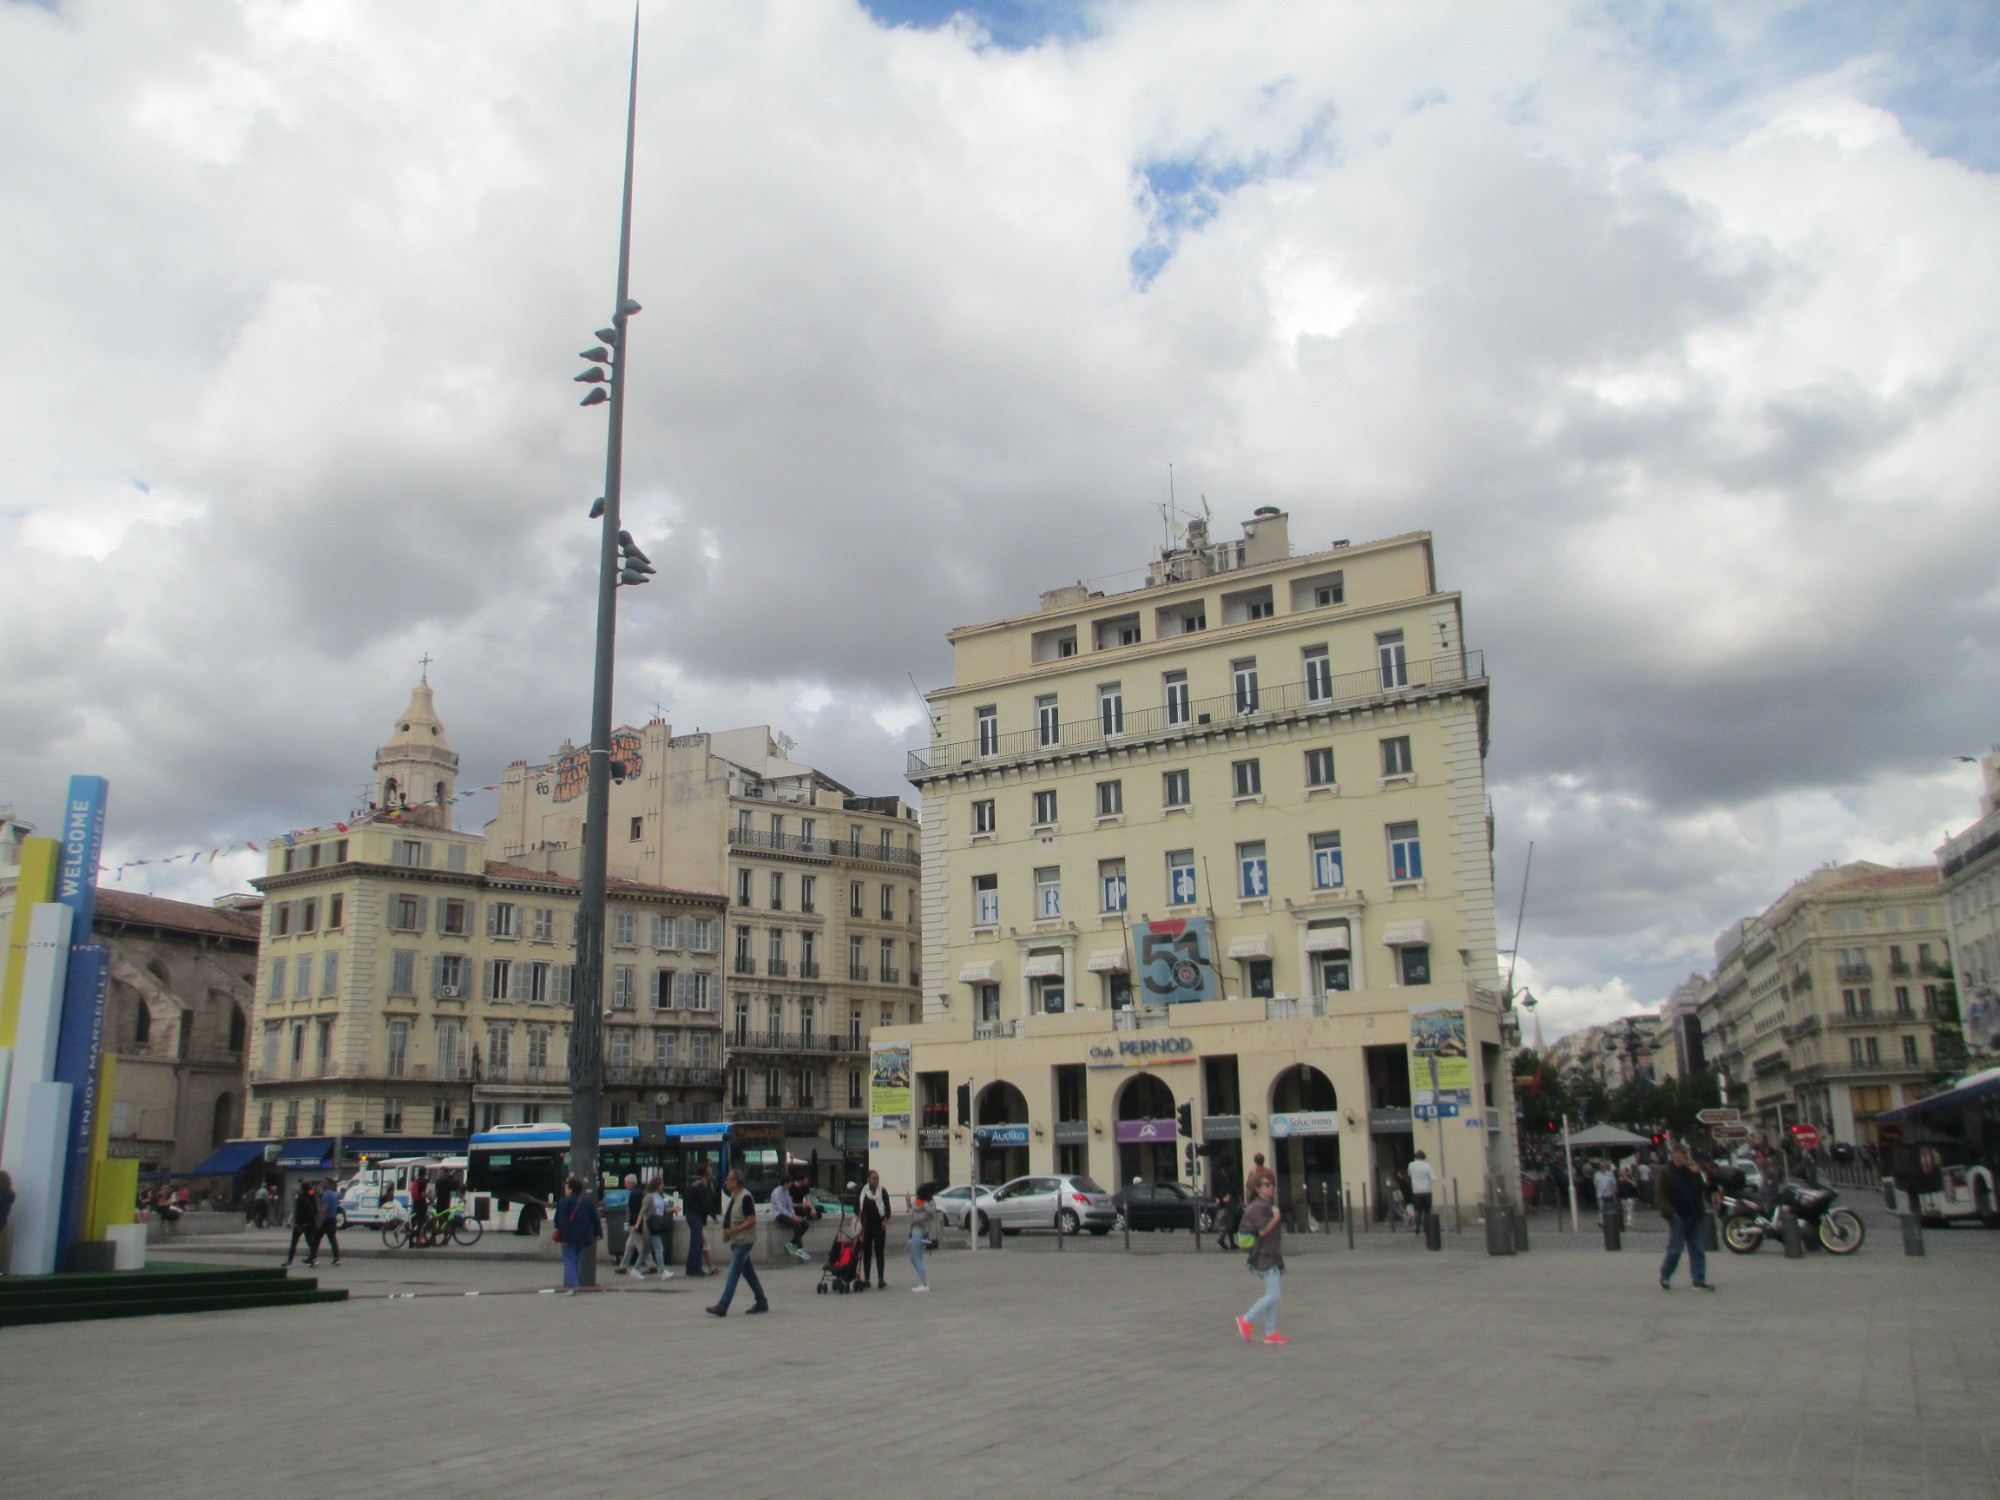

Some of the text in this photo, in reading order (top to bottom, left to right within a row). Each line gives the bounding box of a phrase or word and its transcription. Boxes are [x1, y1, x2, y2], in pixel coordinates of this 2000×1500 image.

[61, 801, 90, 897] WELCOME
[88, 809, 104, 888] ACCUEIL
[80, 1076, 97, 1135] ENJOY
[89, 964, 108, 1070] MARSEILLE
[1089, 1036, 1192, 1057] Club PERNOD
[991, 1130, 1026, 1142] Audika
